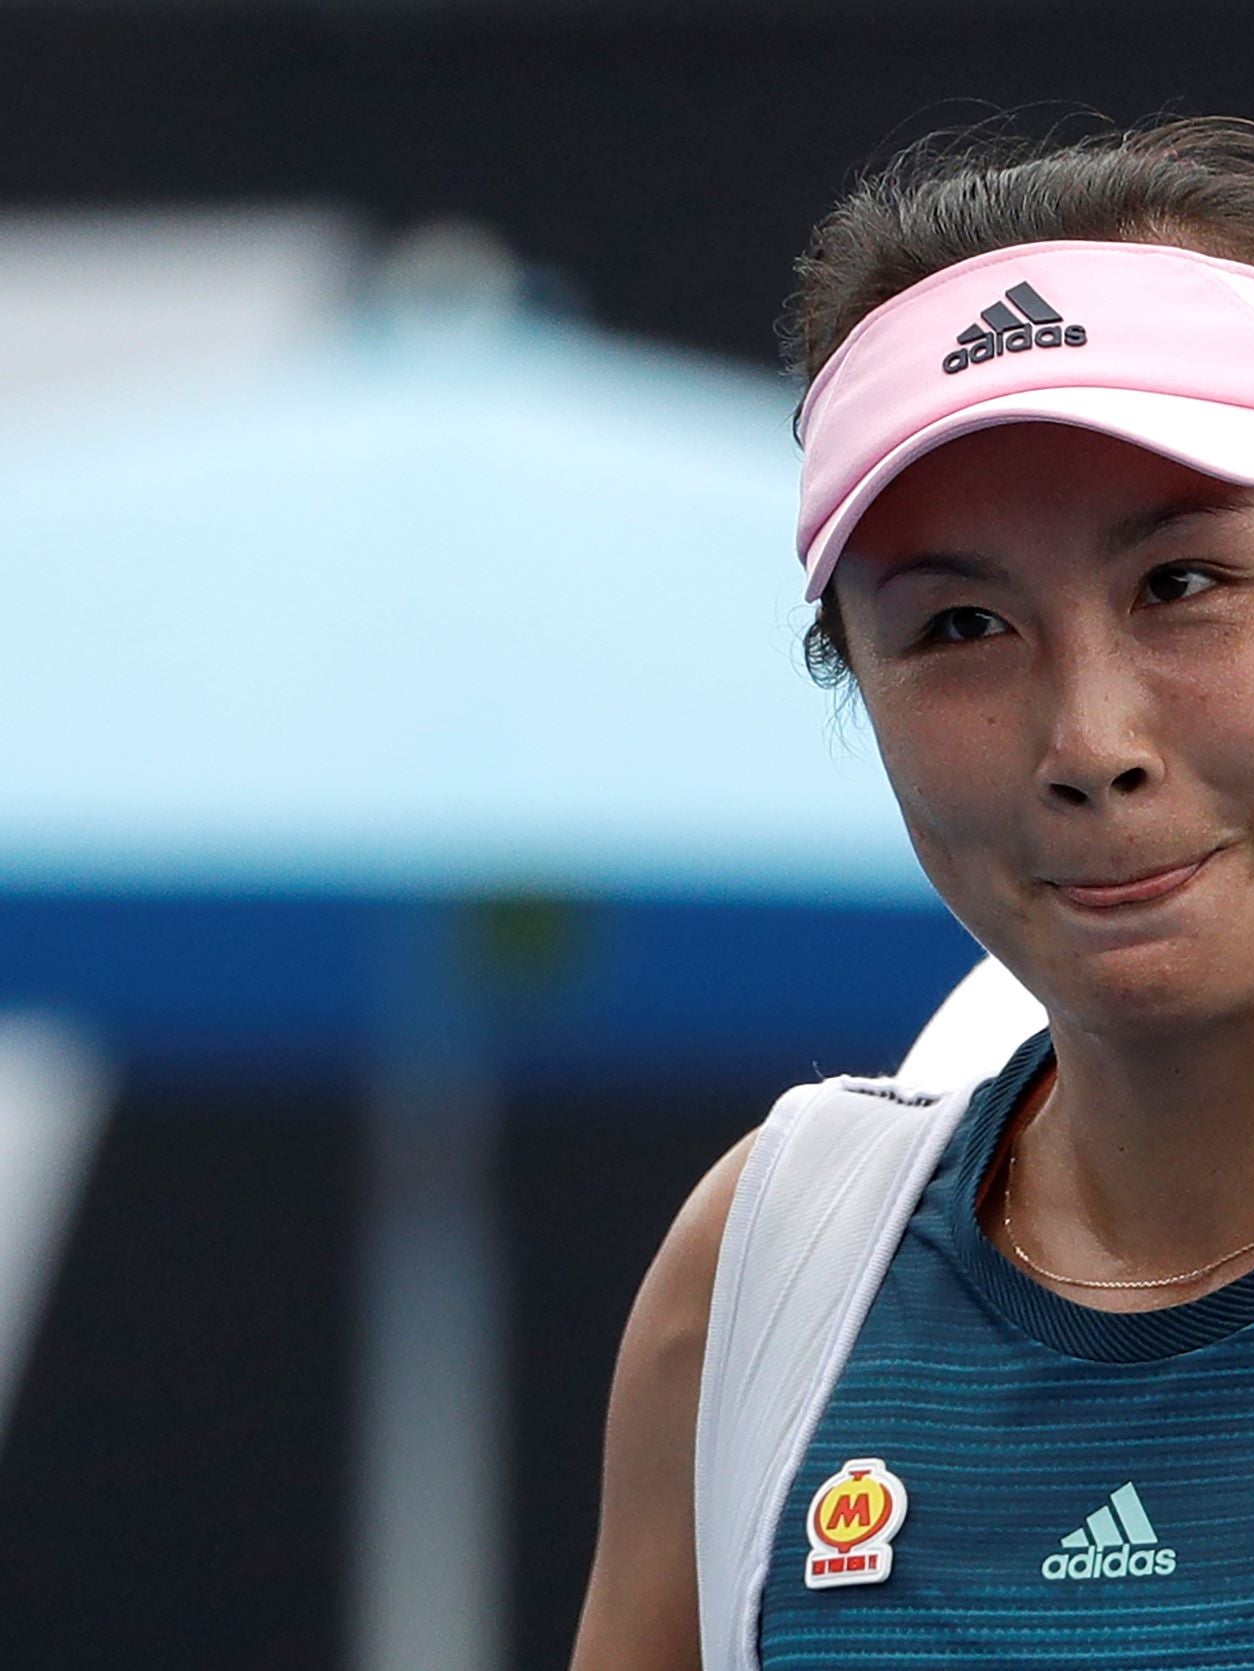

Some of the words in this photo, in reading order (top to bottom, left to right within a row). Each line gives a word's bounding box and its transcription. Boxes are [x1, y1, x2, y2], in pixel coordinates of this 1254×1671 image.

[942, 322, 1087, 374] adidas
[826, 1492, 871, 1531] M
[1041, 1543, 1177, 1580] adidas
